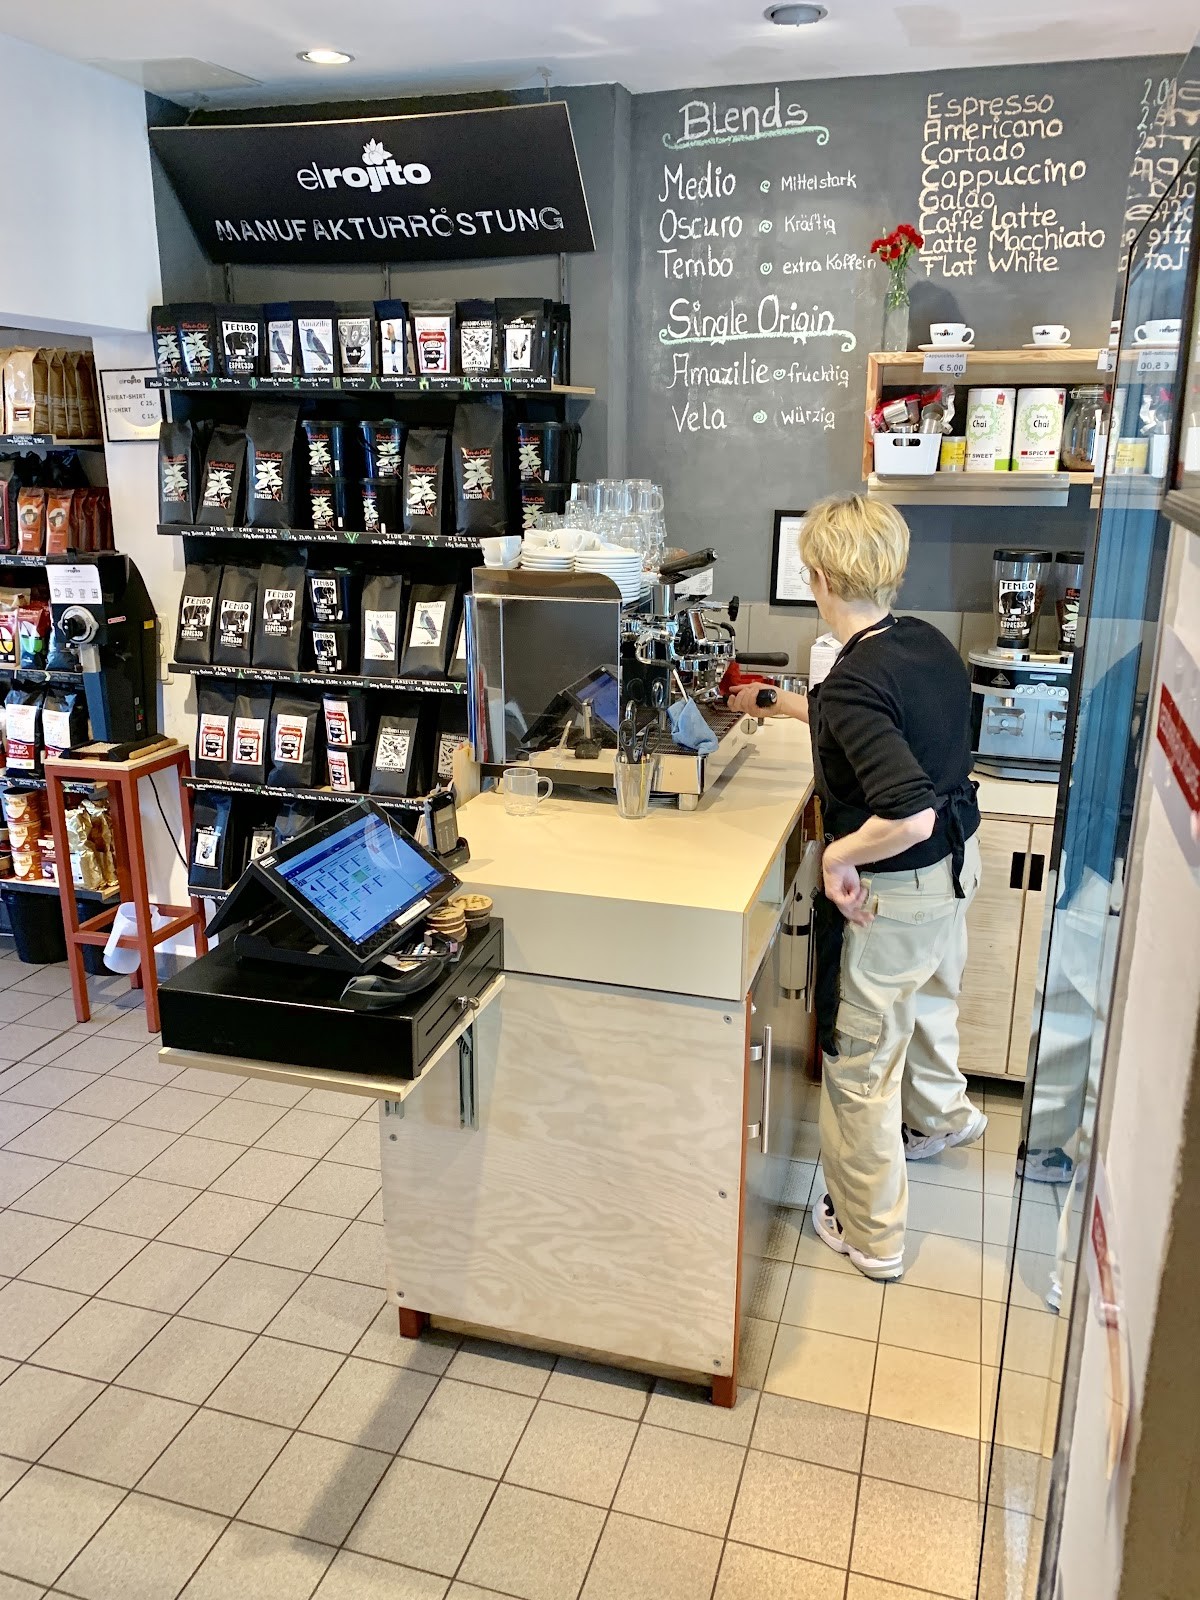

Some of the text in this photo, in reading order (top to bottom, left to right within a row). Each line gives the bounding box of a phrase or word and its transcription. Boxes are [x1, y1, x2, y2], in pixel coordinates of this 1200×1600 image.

[677, 87, 808, 142] Blends
[927, 92, 1054, 121] Espresso
[924, 118, 1064, 142] Americano
[921, 140, 1026, 167] Cortado
[658, 160, 736, 202] Medio
[921, 159, 1087, 192] Cappuccino
[918, 188, 996, 213] Galão
[659, 209, 742, 243] Oscuro
[784, 212, 836, 235] Kräftig
[991, 201, 1058, 230] Latte
[920, 221, 1106, 256] Latte Macchiato
[657, 245, 733, 279] Tembo
[782, 257, 822, 274] extra
[918, 249, 1060, 277] Flat White
[224, 322, 256, 332] TEMBO
[668, 294, 835, 346] Single Origin
[666, 352, 770, 389] Amazilie
[938, 364, 964, 373] € 5,00
[671, 405, 727, 432] Vela
[780, 405, 835, 430] würzig
[972, 419, 987, 428] Chai
[1033, 419, 1050, 428] Chai
[267, 590, 294, 598] TEMBO
[1001, 582, 1035, 590] TEMBO
[185, 597, 211, 605] TEMBO
[223, 601, 250, 611] TEMBO
[1000, 621, 1027, 630] ESPRESSO
